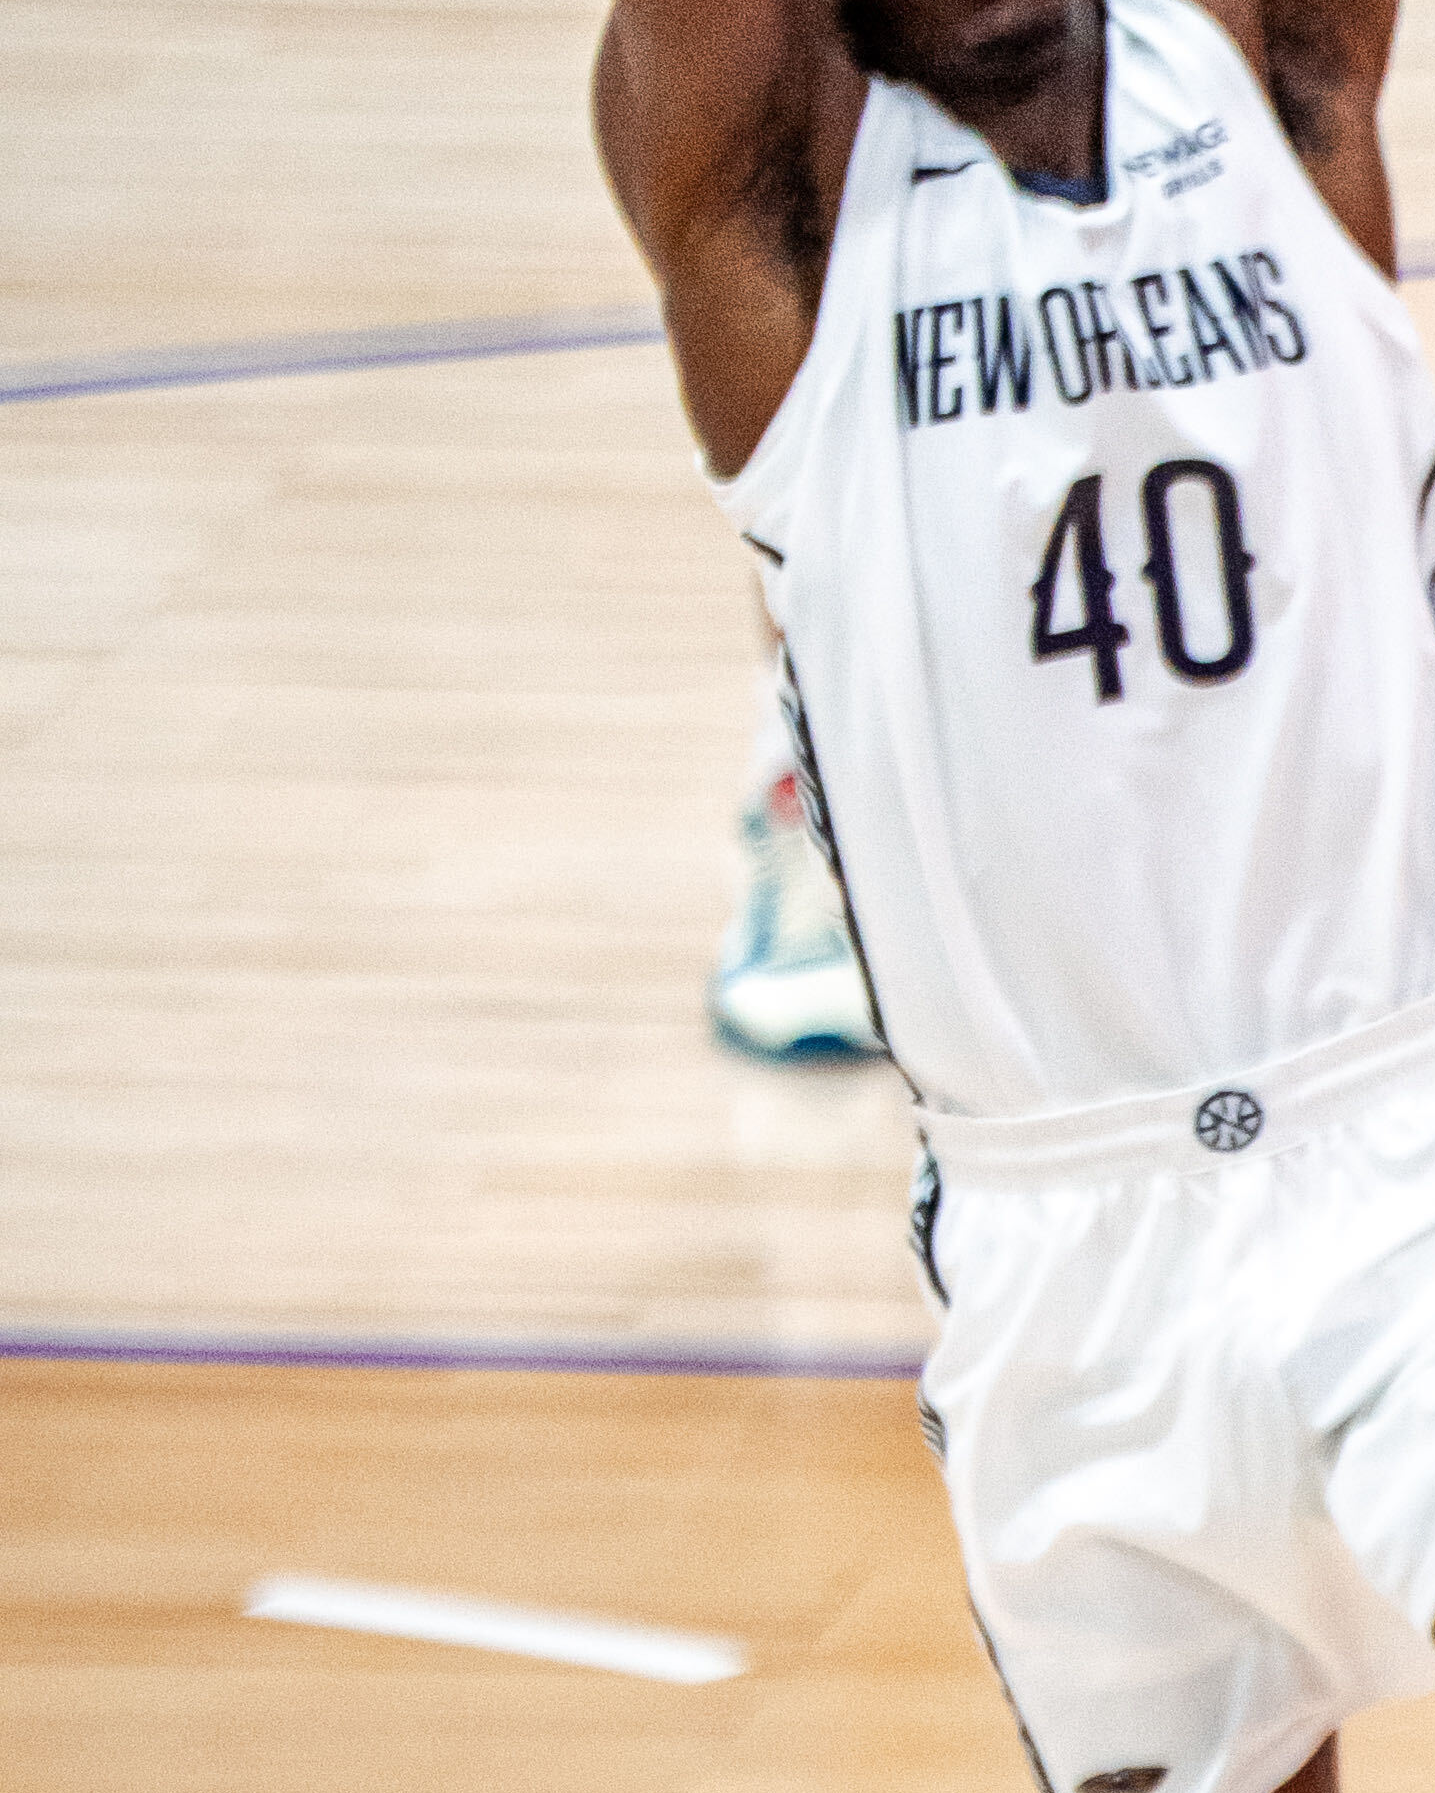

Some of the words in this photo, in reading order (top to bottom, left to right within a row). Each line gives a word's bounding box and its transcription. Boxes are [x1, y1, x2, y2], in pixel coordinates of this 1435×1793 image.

[893, 294, 1031, 429] NEW
[1038, 251, 1308, 407] OREANS
[1028, 458, 1256, 705] 40
